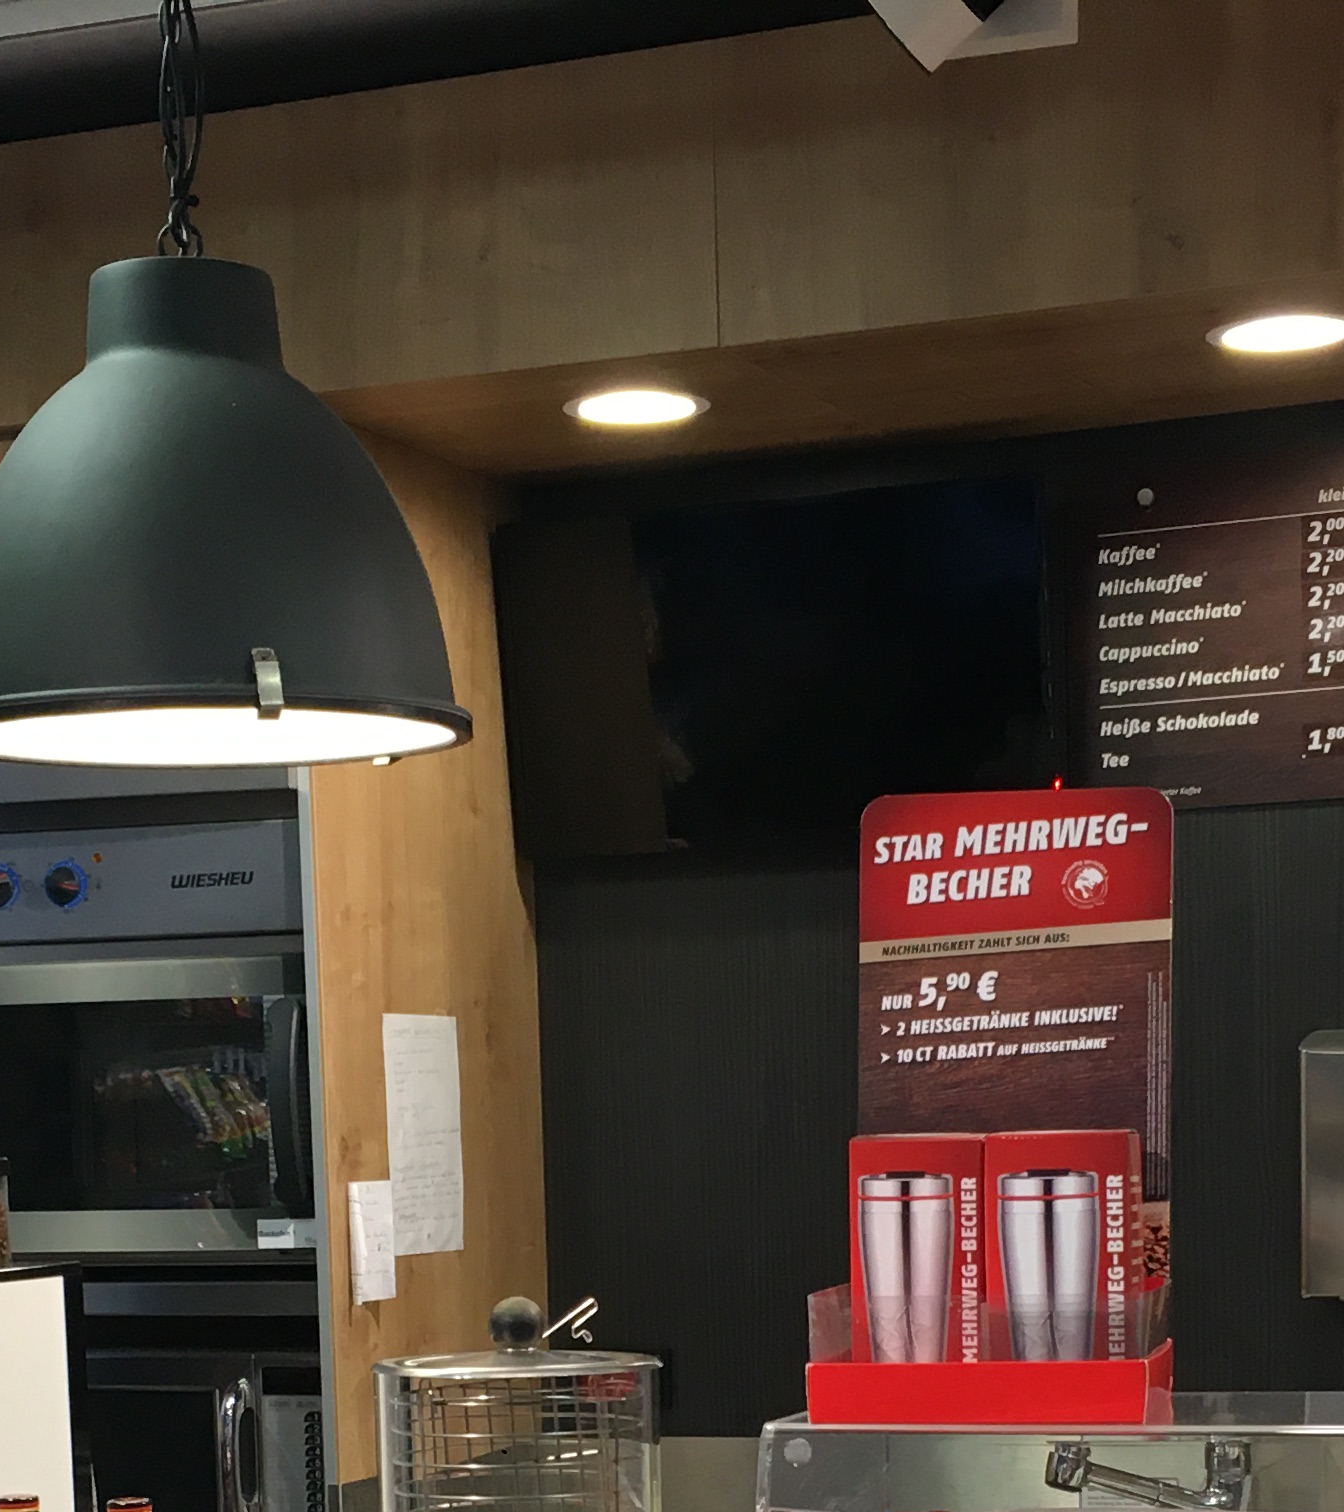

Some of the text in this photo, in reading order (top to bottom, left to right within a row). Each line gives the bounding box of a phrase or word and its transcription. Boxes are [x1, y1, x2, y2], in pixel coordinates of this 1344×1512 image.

[1098, 611, 1144, 629] Latte
[1100, 709, 1260, 738] Heiße Schokolade
[1101, 753, 1130, 768] Tee
[873, 812, 1150, 865] STAR MEHRWEG-
[170, 870, 254, 890] WIESHEU
[906, 865, 1033, 906] BECHER
[881, 939, 975, 957] NACHHALTIGKEIT
[978, 936, 1012, 950] ZAHLT
[1015, 934, 1040, 947] SICH
[881, 994, 913, 1011] NUR
[896, 1021, 906, 1037] 2
[910, 1009, 1031, 1036] HEISSGETRÄNKE
[937, 1041, 997, 1061] RABATT
[996, 1044, 1019, 1057] AUF
[1106, 1174, 1125, 1360] EHRWEG-BECHER
